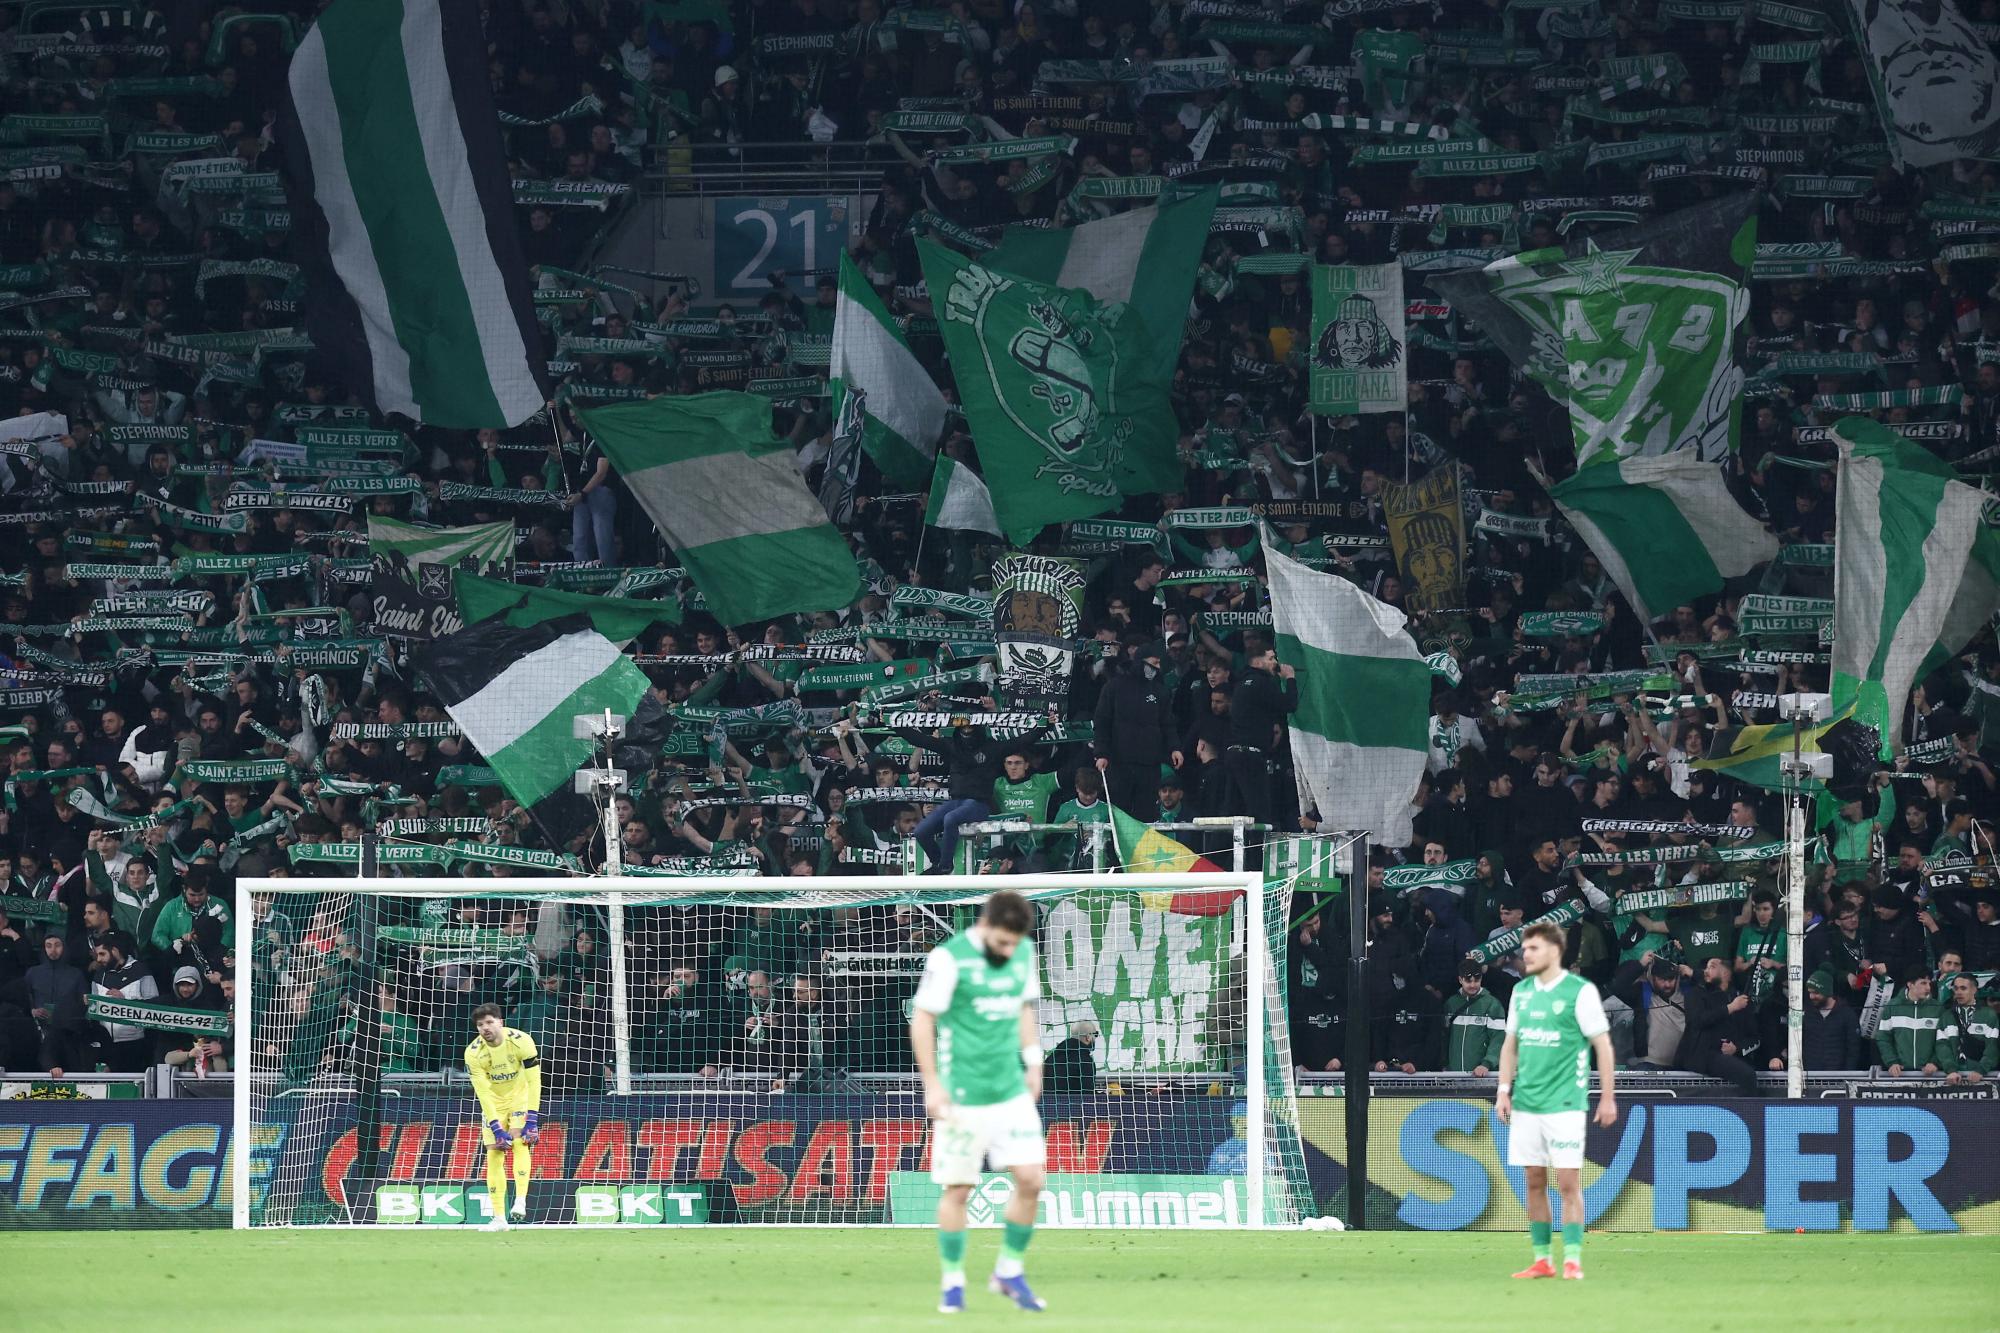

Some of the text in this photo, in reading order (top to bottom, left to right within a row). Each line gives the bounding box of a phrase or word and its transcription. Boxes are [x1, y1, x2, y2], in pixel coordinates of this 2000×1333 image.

[1377, 140, 1473, 158] ALLEZ LES VERTS
[1442, 155, 1537, 172] ALLEZ LES VERTS
[1453, 206, 1479, 223] VERT
[732, 207, 816, 287] 21
[571, 382, 606, 398] ALLEZ
[608, 387, 630, 399] LES
[306, 431, 399, 448] ALLEZ LES VERTS
[331, 476, 421, 493] ALLEZ LES VERTS
[288, 493, 351, 511] ANGELS
[1071, 523, 1165, 544] ALLEZ LES VERTS
[71, 563, 166, 578] GENERATION KOP
[196, 556, 233, 569] ALLEZ
[1752, 615, 1814, 631] ALLEZ LES
[811, 671, 874, 684] AS SAINT-ETIENNE
[911, 667, 972, 690] VERTS
[890, 710, 1042, 729] GREEN ANGELS
[197, 762, 288, 777] SAINT-ETIENNE
[320, 842, 357, 859] ALLEZ
[463, 844, 506, 862] ALLEZ
[507, 849, 530, 864] LES
[1626, 850, 1651, 863] LES
[1654, 844, 1700, 862] VERTS
[1621, 881, 1747, 913] GREEN ANGELS
[99, 1003, 143, 1019] GREEN
[1394, 1099, 1964, 1233] SUPER
[580, 1191, 703, 1218] BKT
